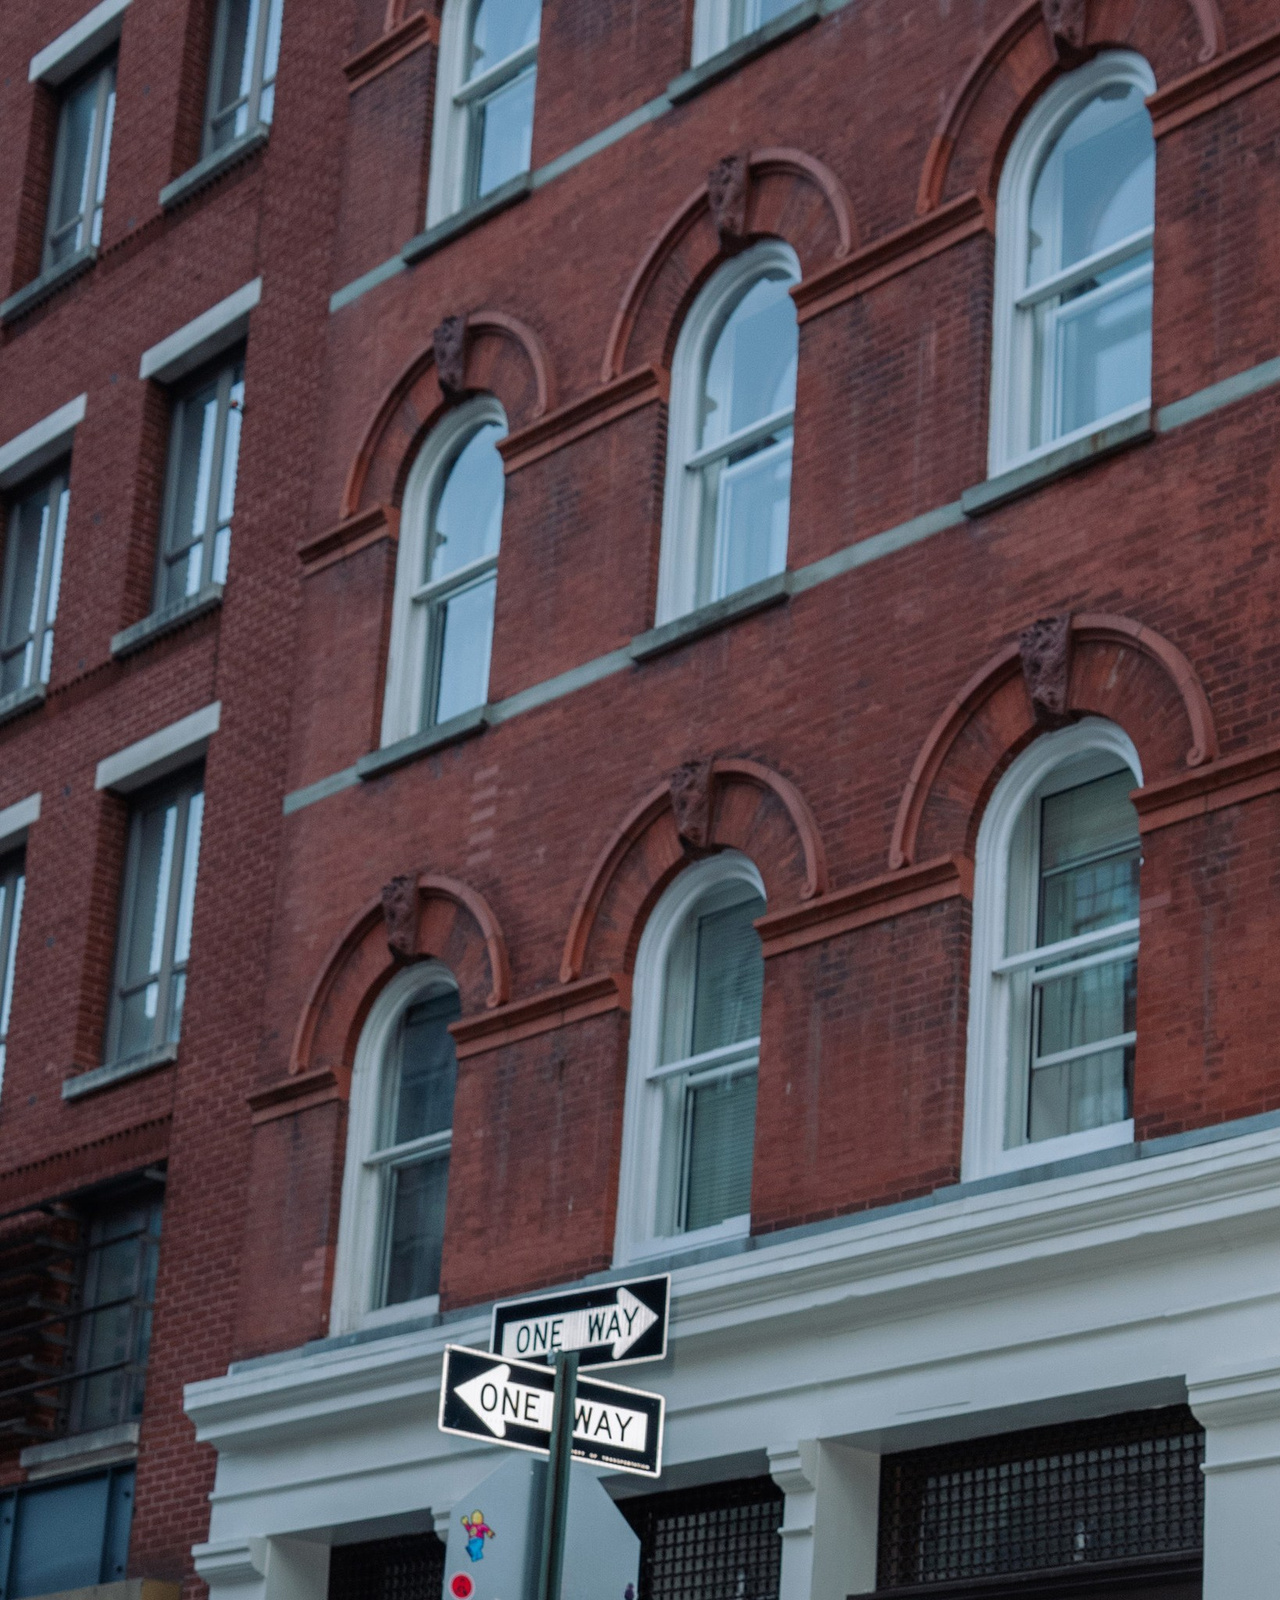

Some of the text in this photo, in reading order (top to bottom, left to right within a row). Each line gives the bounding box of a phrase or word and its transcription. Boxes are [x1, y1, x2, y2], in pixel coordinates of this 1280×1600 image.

[516, 1305, 640, 1353] ONE WAY
[480, 1382, 633, 1443] ONE WAY
